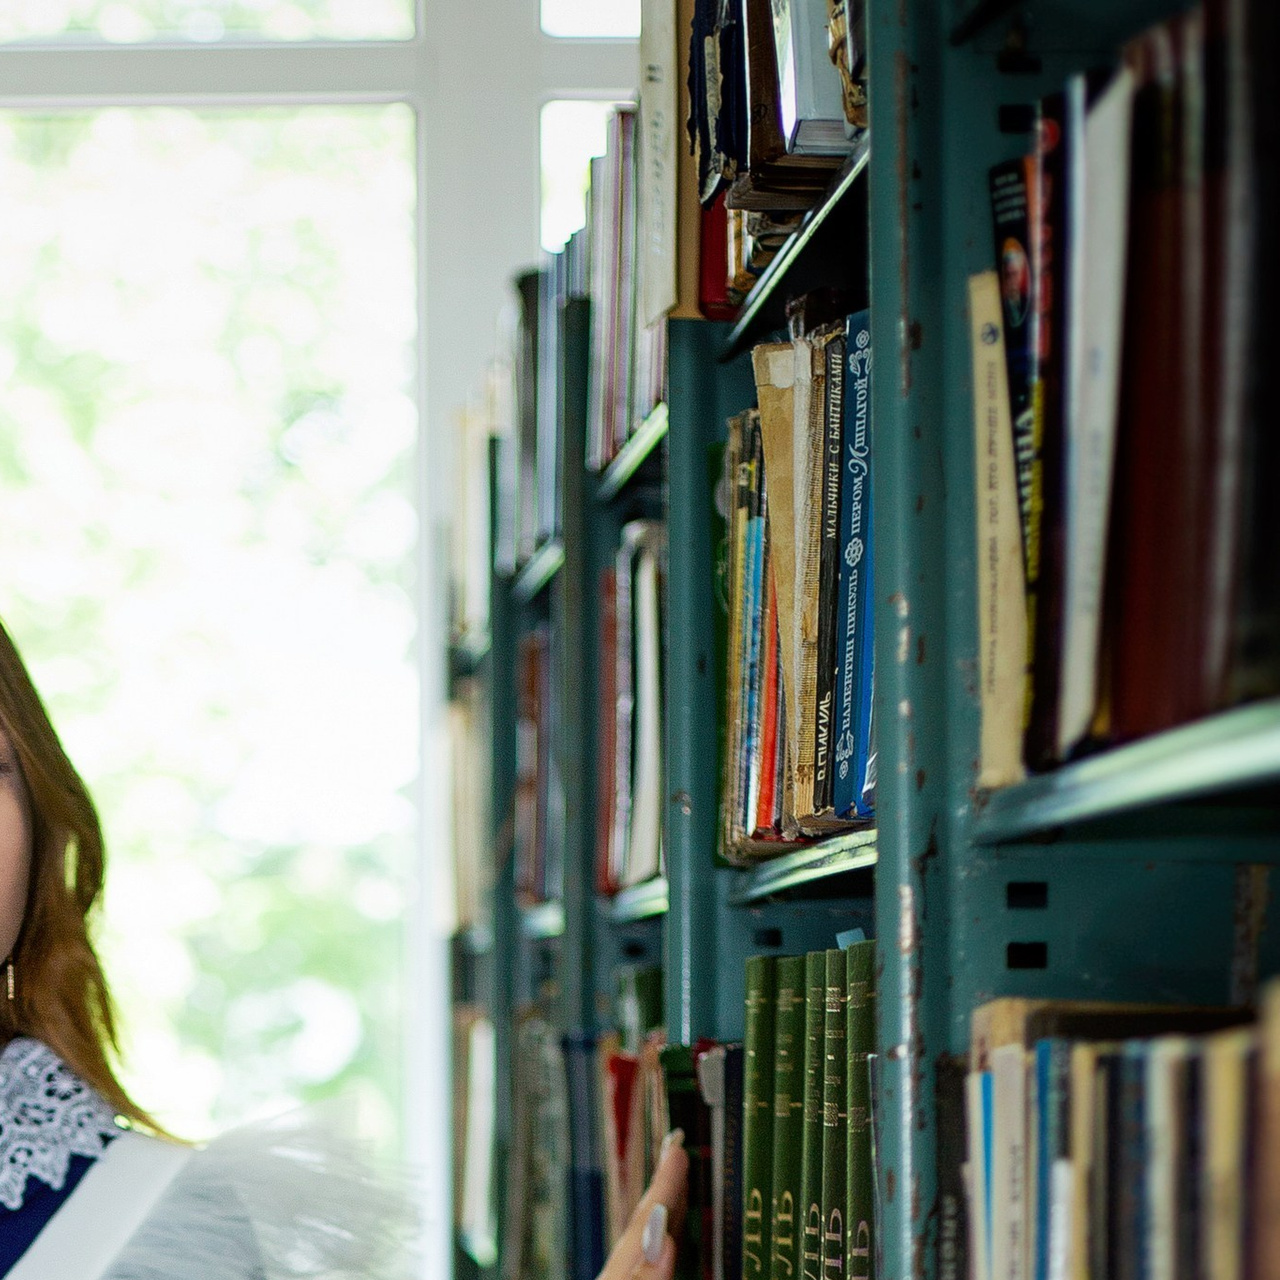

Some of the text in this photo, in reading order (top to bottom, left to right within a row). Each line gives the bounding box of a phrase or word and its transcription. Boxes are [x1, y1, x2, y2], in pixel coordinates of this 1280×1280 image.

[830, 353, 843, 440] БАНТИКАМИ
[852, 379, 868, 446] ШПАГОЙ
[826, 463, 838, 539] МАЛЬЧИКИ
[850, 476, 864, 535] ПЕРОМ
[842, 569, 859, 732] ВАЛЕНТИН ПИКУЛЬ
